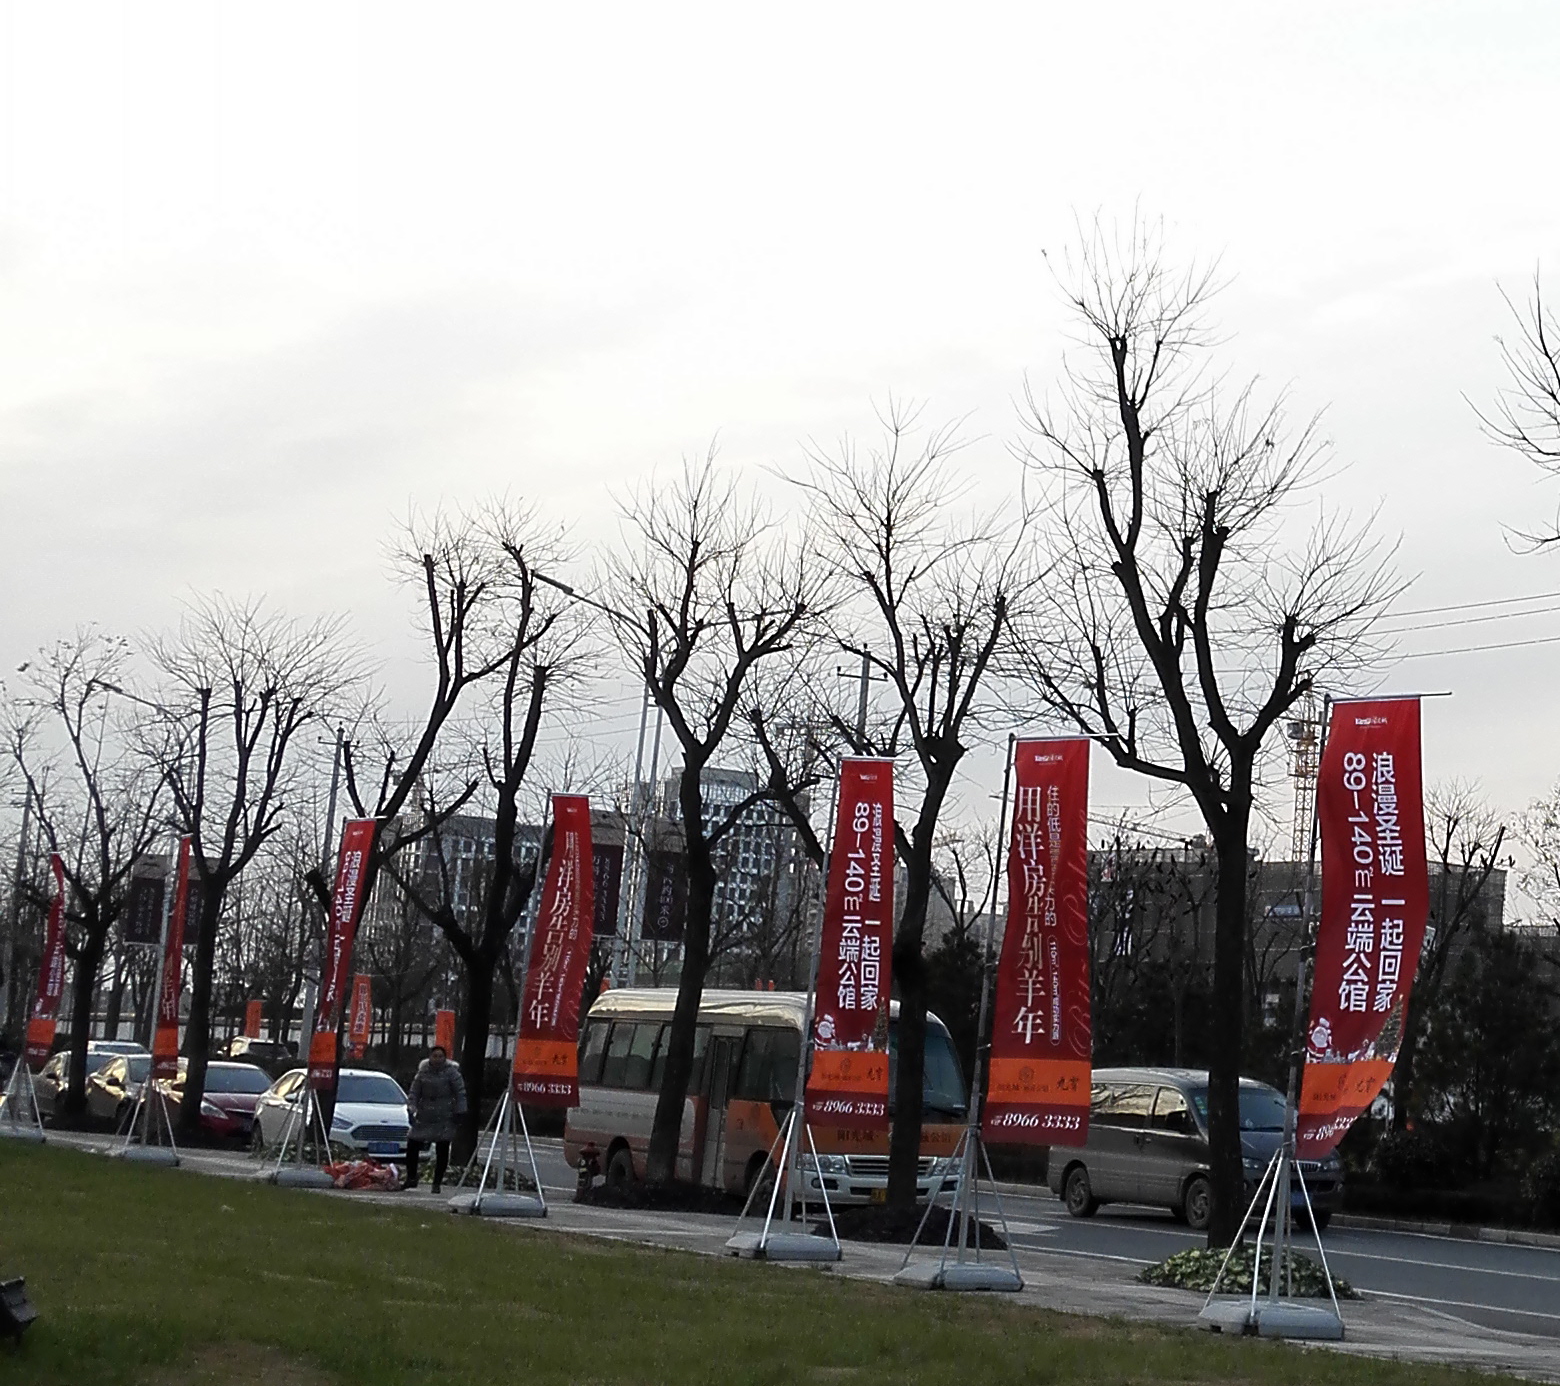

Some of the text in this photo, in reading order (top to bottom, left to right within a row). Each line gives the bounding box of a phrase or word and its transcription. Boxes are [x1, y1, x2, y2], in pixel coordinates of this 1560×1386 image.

[823, 1100, 853, 1114] 8966
[854, 1102, 885, 1116] 3333
[1002, 1113, 1040, 1128] 8966
[1041, 1114, 1081, 1130] 3333
